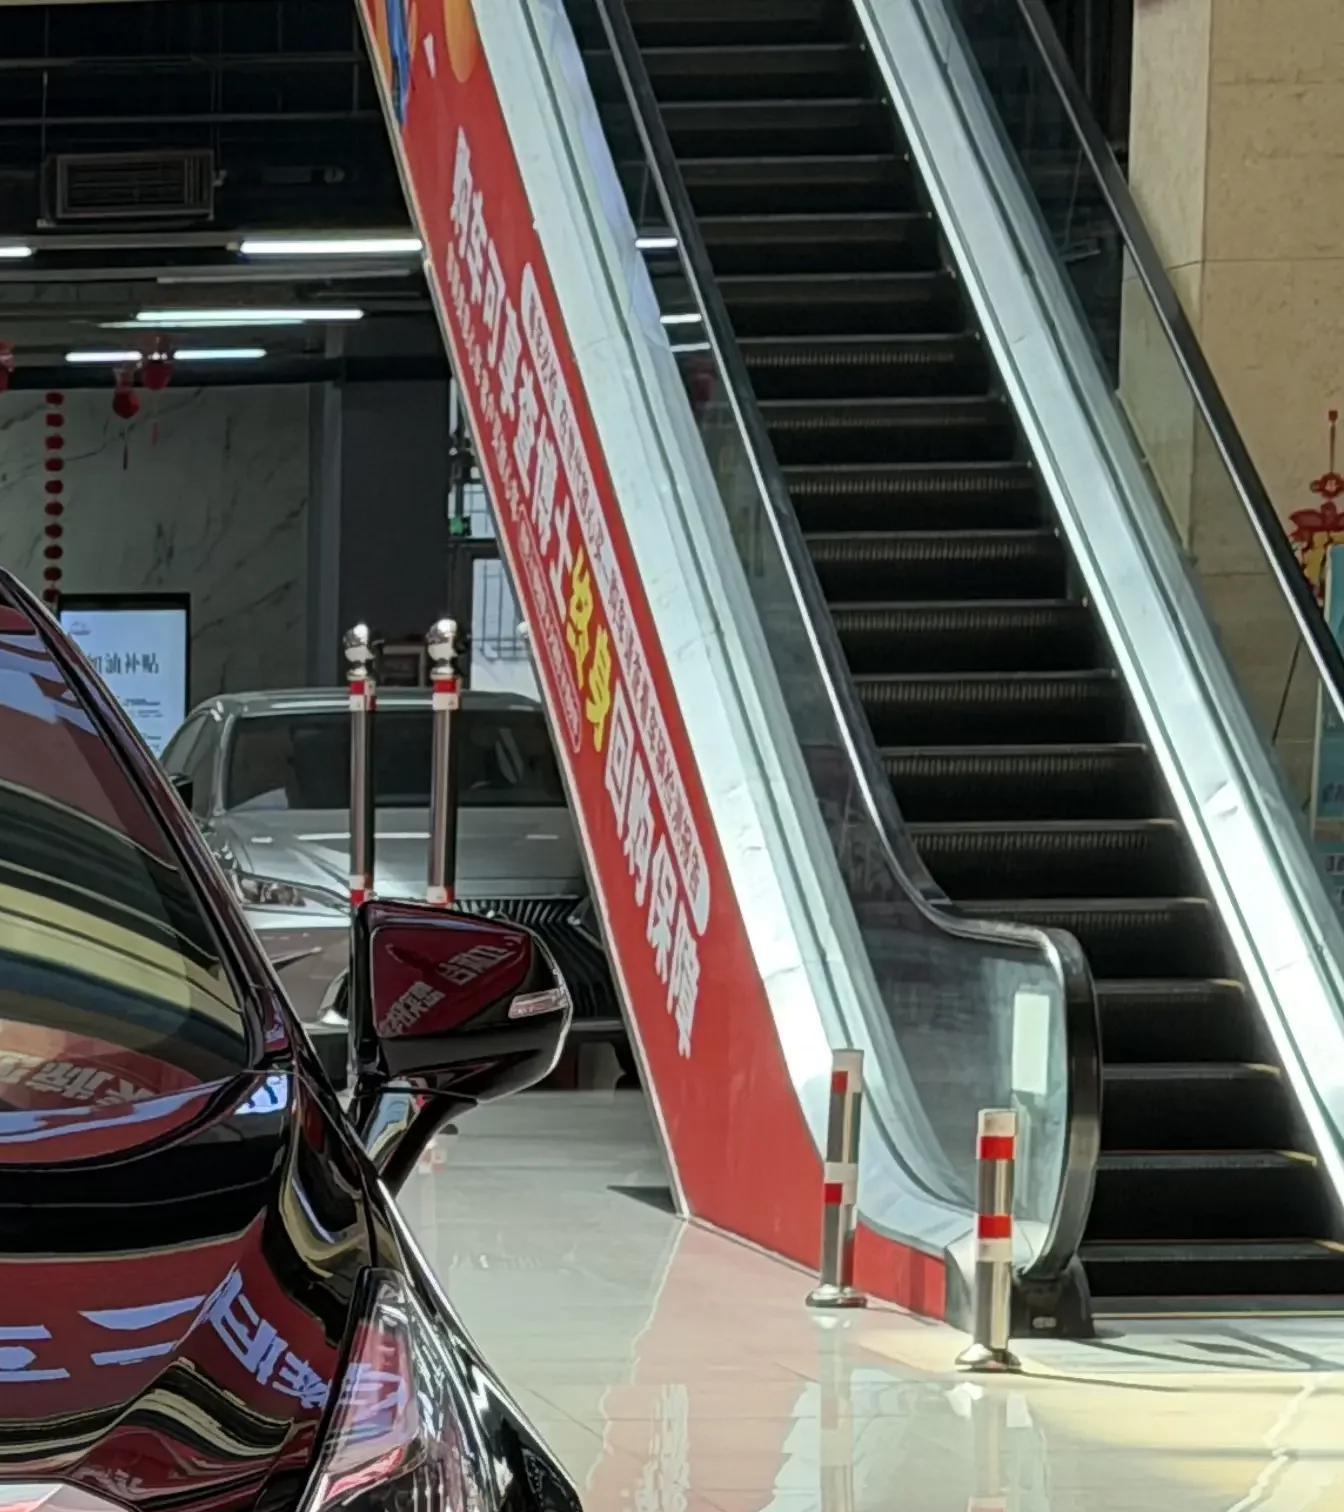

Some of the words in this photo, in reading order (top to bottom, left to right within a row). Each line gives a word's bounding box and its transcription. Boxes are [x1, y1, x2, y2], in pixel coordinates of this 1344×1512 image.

[450, 126, 700, 1060] 购车可享查博士终身回购保障
